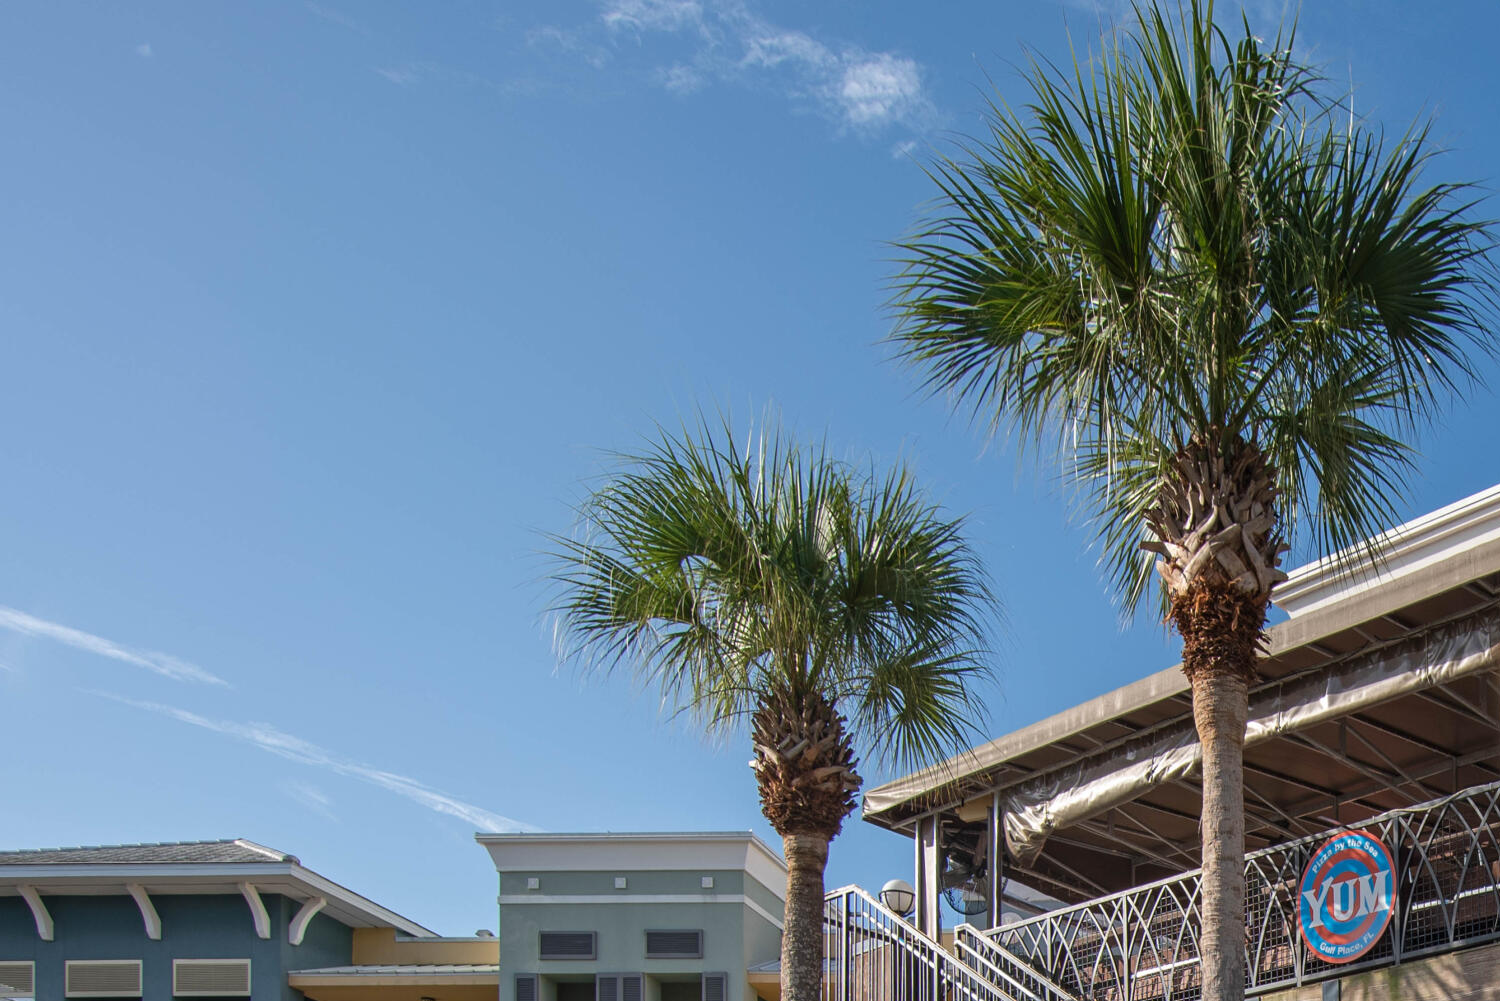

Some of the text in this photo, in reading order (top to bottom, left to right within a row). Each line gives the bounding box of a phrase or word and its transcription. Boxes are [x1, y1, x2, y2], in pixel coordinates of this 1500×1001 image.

[1312, 839, 1379, 873] Pizza by the Sea
[1301, 869, 1390, 929] YUM
[1319, 942, 1336, 955] Gulf
[1363, 932, 1375, 943] FL
